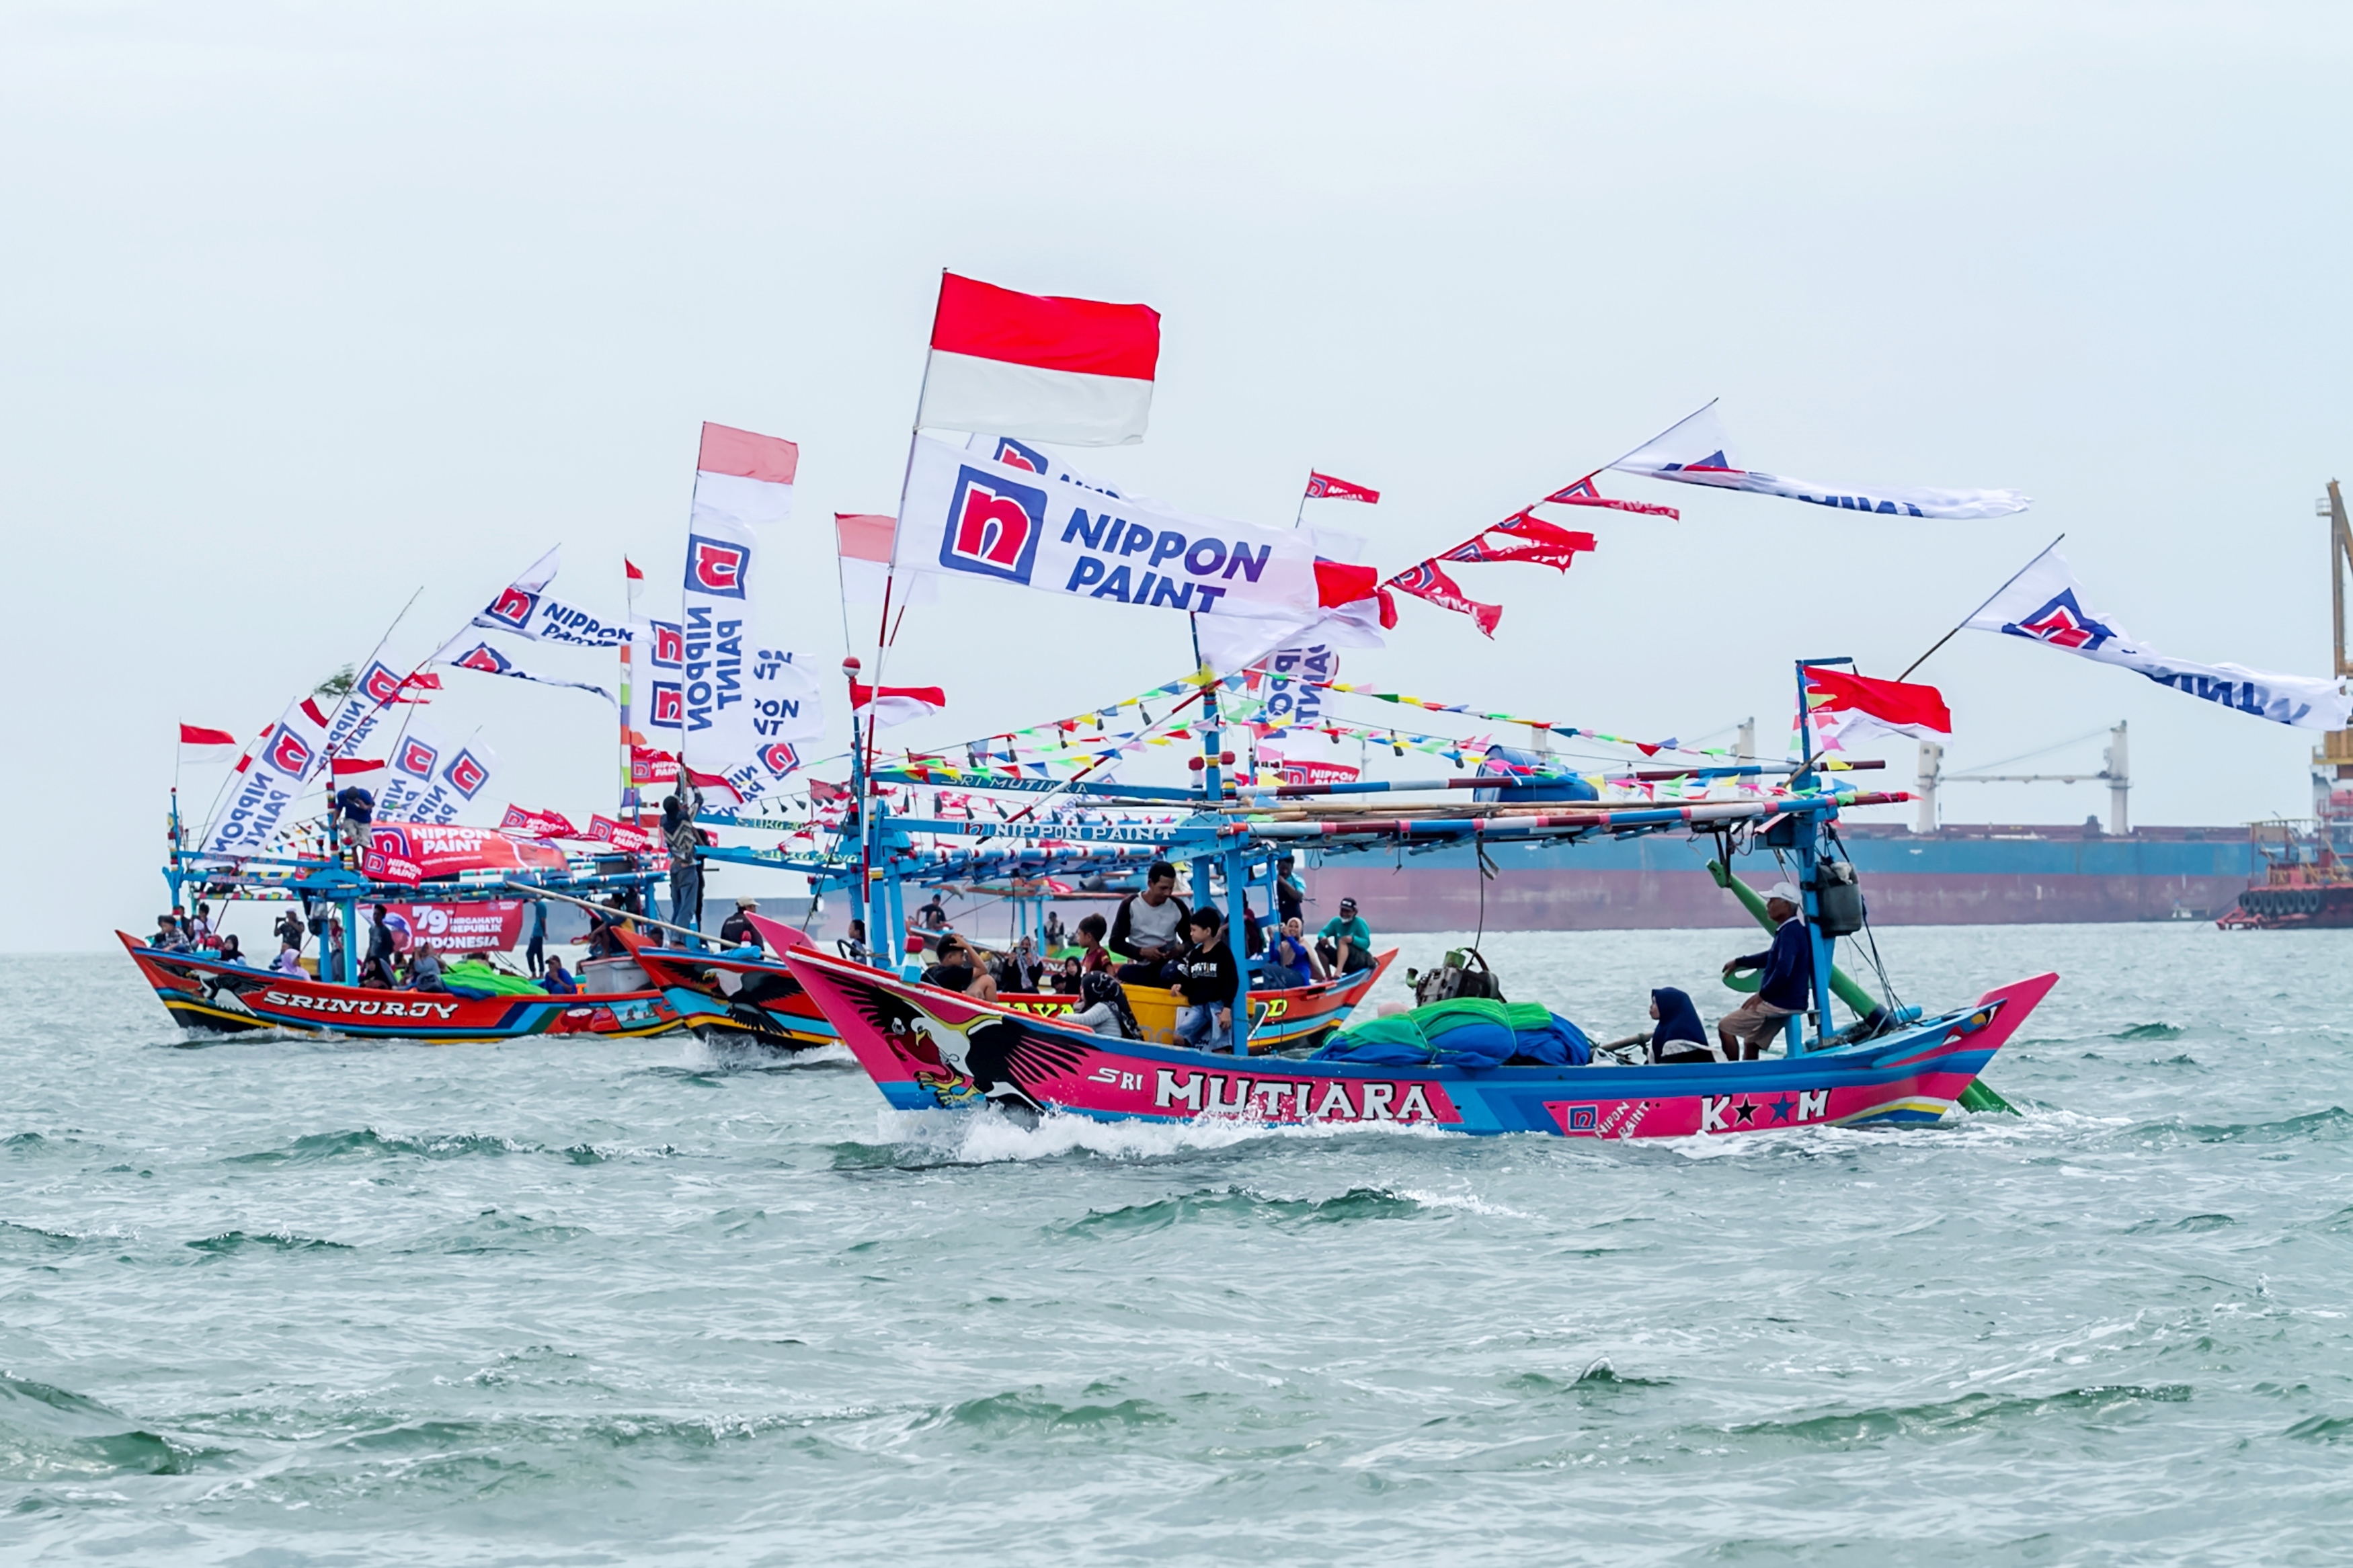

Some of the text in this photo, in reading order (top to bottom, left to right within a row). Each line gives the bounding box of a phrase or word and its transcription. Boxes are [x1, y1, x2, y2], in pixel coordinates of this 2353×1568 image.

[1060, 507, 1272, 583] NIPPON
[1066, 555, 1227, 614] PAINT
[543, 602, 634, 642] NIPPON
[651, 761, 682, 770] NIPPO
[654, 767, 680, 777] PAIN
[1310, 769, 1357, 782] NIPPON
[411, 827, 491, 840] NIPPON
[612, 827, 649, 843] NIPPON
[995, 823, 1082, 839] NIPPON
[1095, 826, 1177, 841] PAINT
[422, 839, 483, 855] PAINT
[612, 837, 643, 850] PAINT
[387, 858, 422, 876] NIPPON
[388, 867, 416, 881] PAINT
[411, 905, 448, 935] 79
[450, 924, 502, 934] REPUBLIK
[414, 936, 500, 950] INDONESIA
[1087, 1067, 1439, 1120] SRI MUTIARA
[1701, 1088, 1832, 1132] K M
[1594, 1101, 1630, 1139] NIPON
[1618, 1100, 1649, 1139] PAINT
